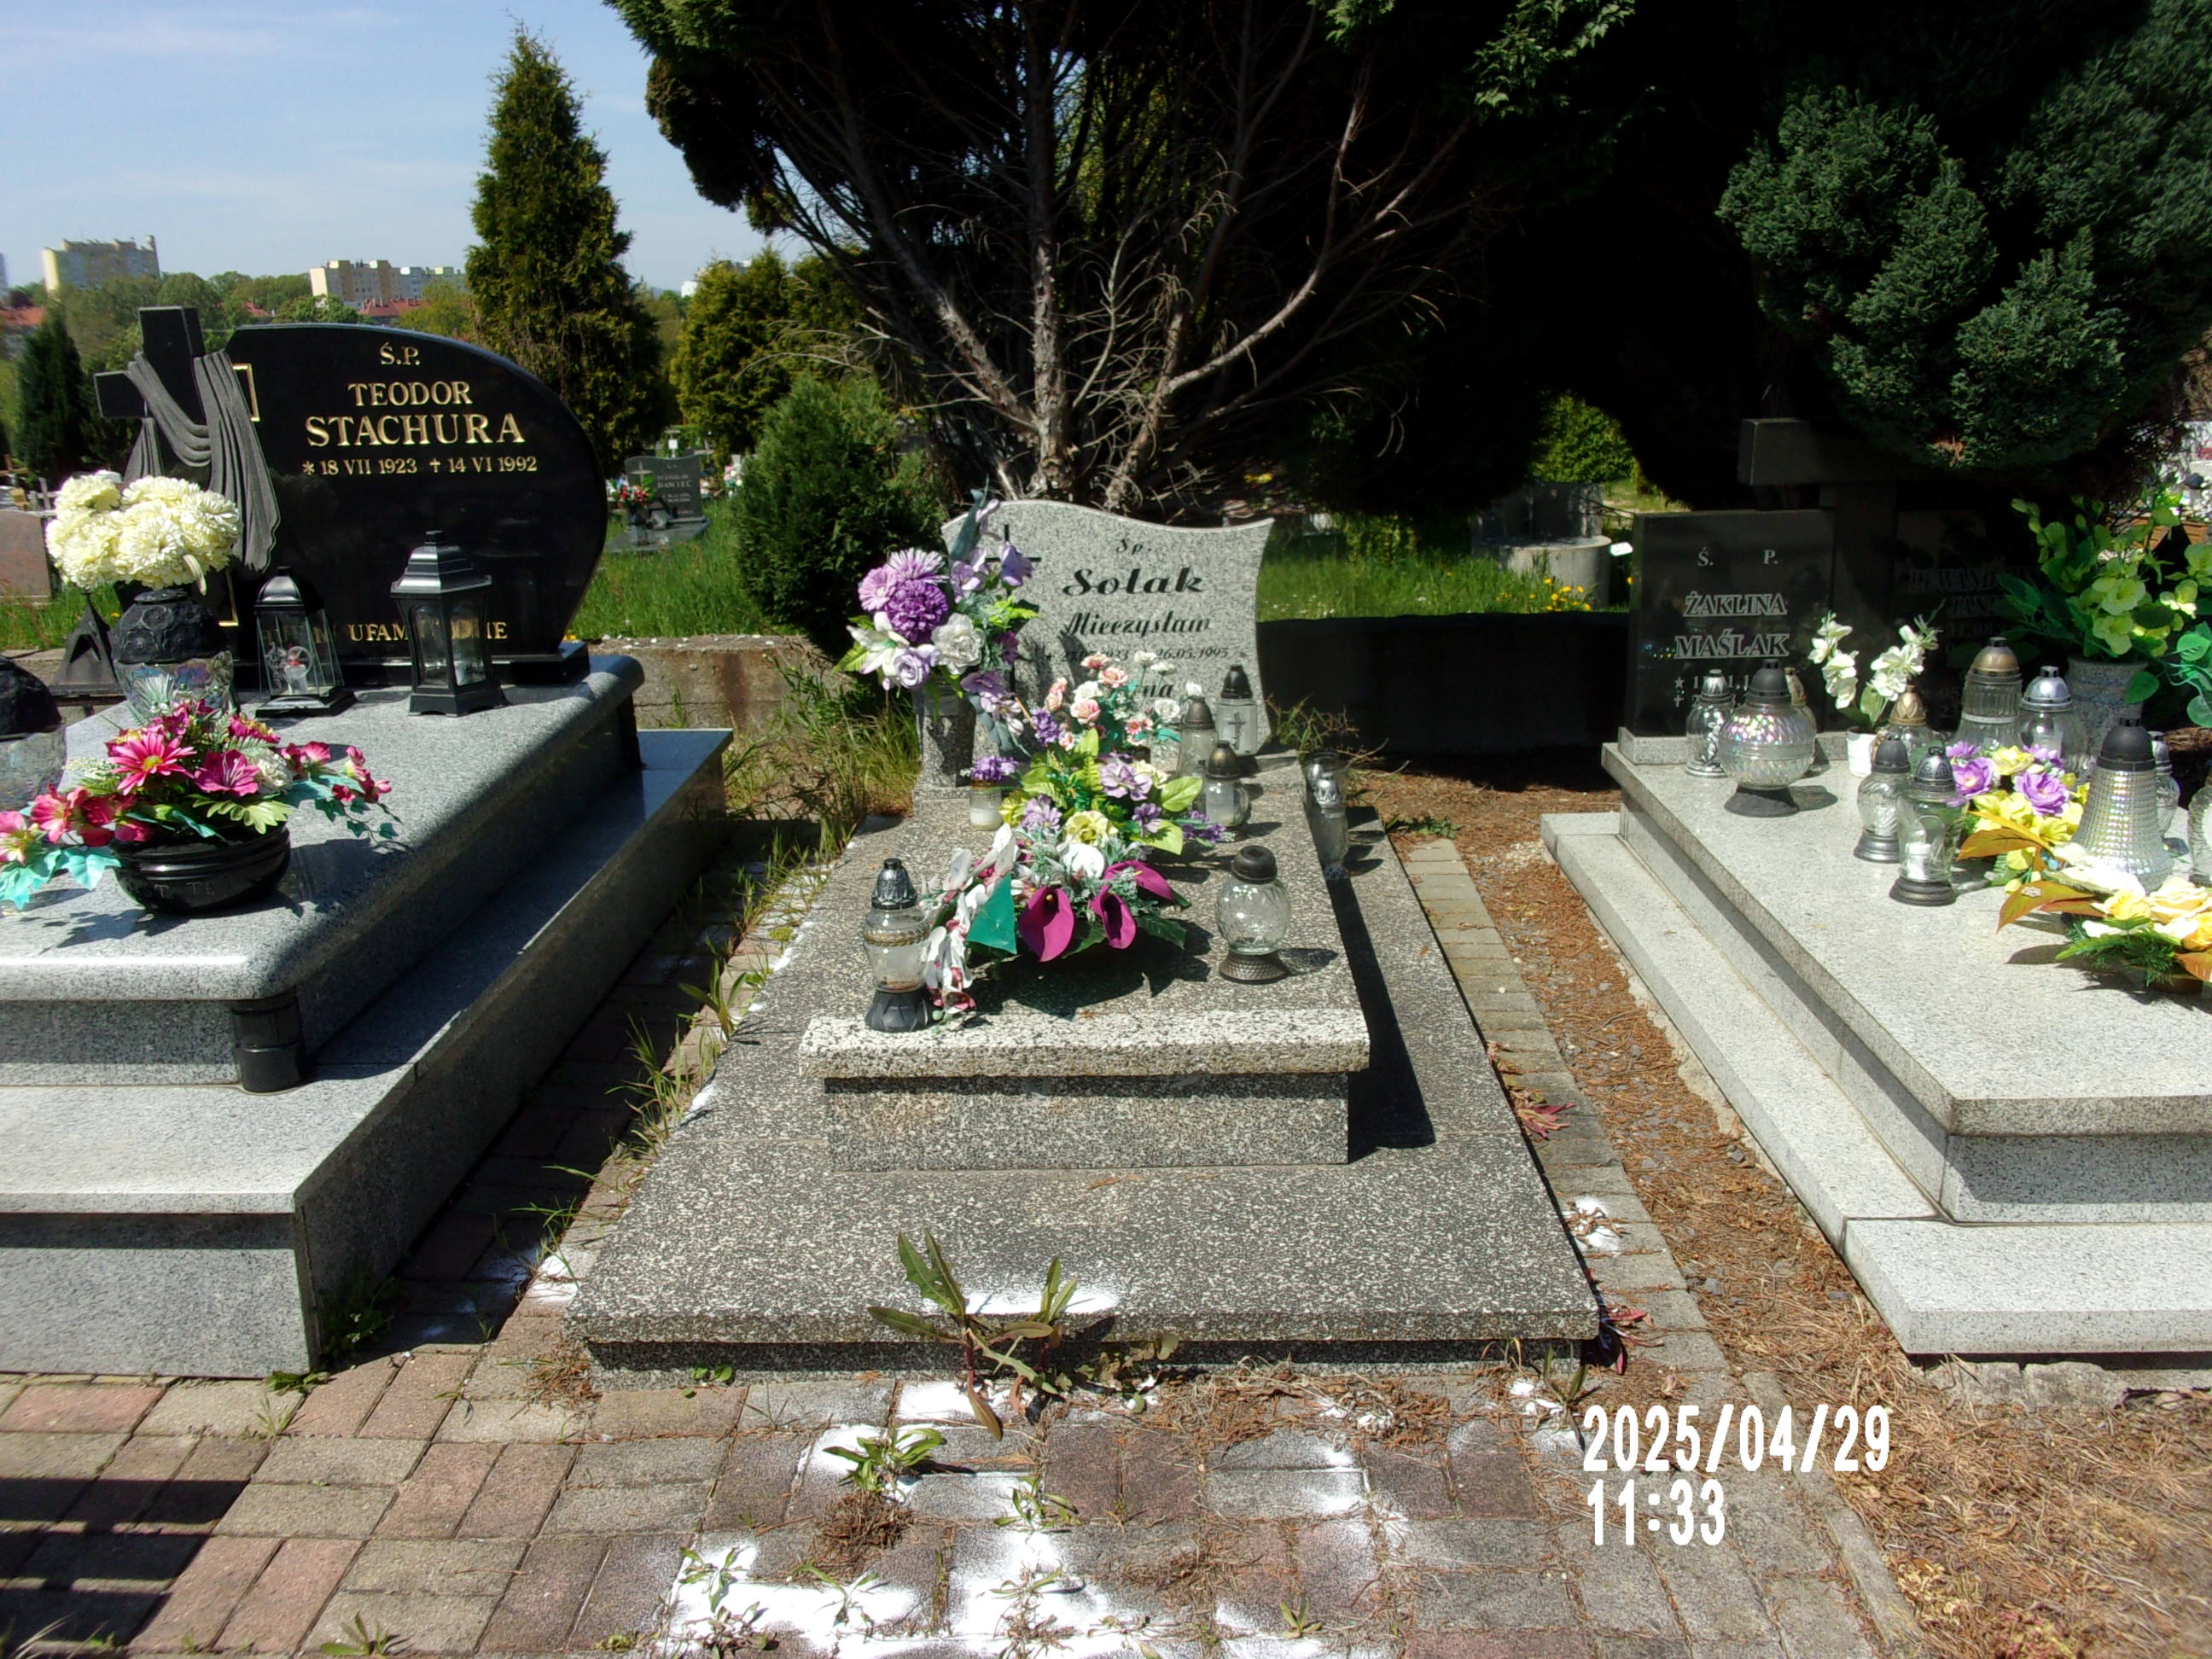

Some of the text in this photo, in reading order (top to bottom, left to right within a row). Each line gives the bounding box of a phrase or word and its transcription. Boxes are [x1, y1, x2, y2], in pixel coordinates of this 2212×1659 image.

[380, 342, 421, 366] Ś.P.
[348, 381, 473, 407] TEODOR
[305, 413, 526, 447] STACHURA
[320, 455, 538, 475] 18 VII 1923 14 VI 1992
[1062, 568, 1203, 596] Solak
[1683, 591, 1789, 617] ŻAKLINA
[346, 622, 409, 642] UFAM
[1674, 628, 1790, 659] MAŚLAK
